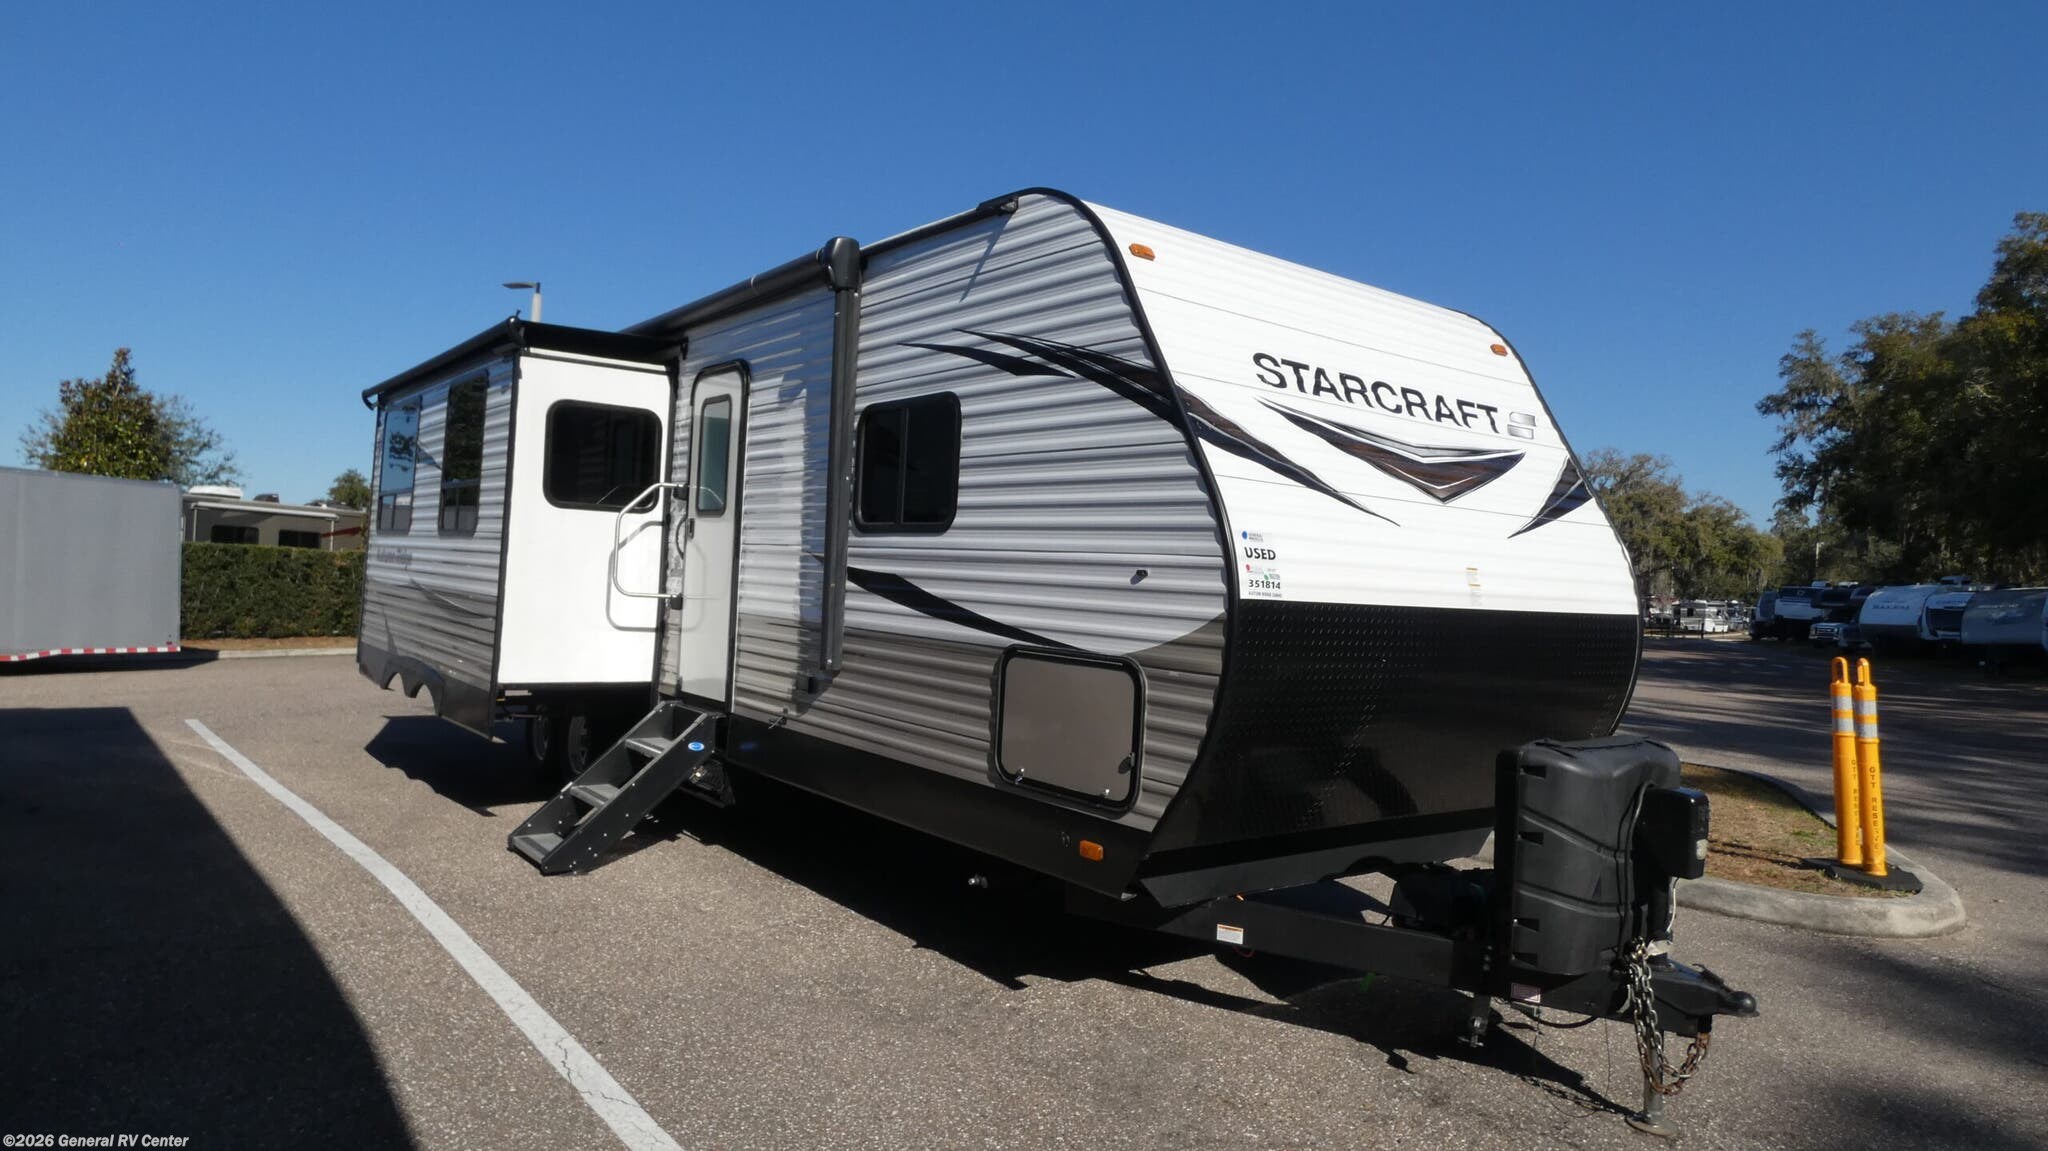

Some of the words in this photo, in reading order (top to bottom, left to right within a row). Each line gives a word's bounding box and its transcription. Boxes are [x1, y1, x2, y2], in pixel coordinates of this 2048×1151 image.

[1253, 352, 1501, 434] STARCRAFT
[1244, 546, 1276, 560] USED
[1248, 579, 1281, 590] 351814
